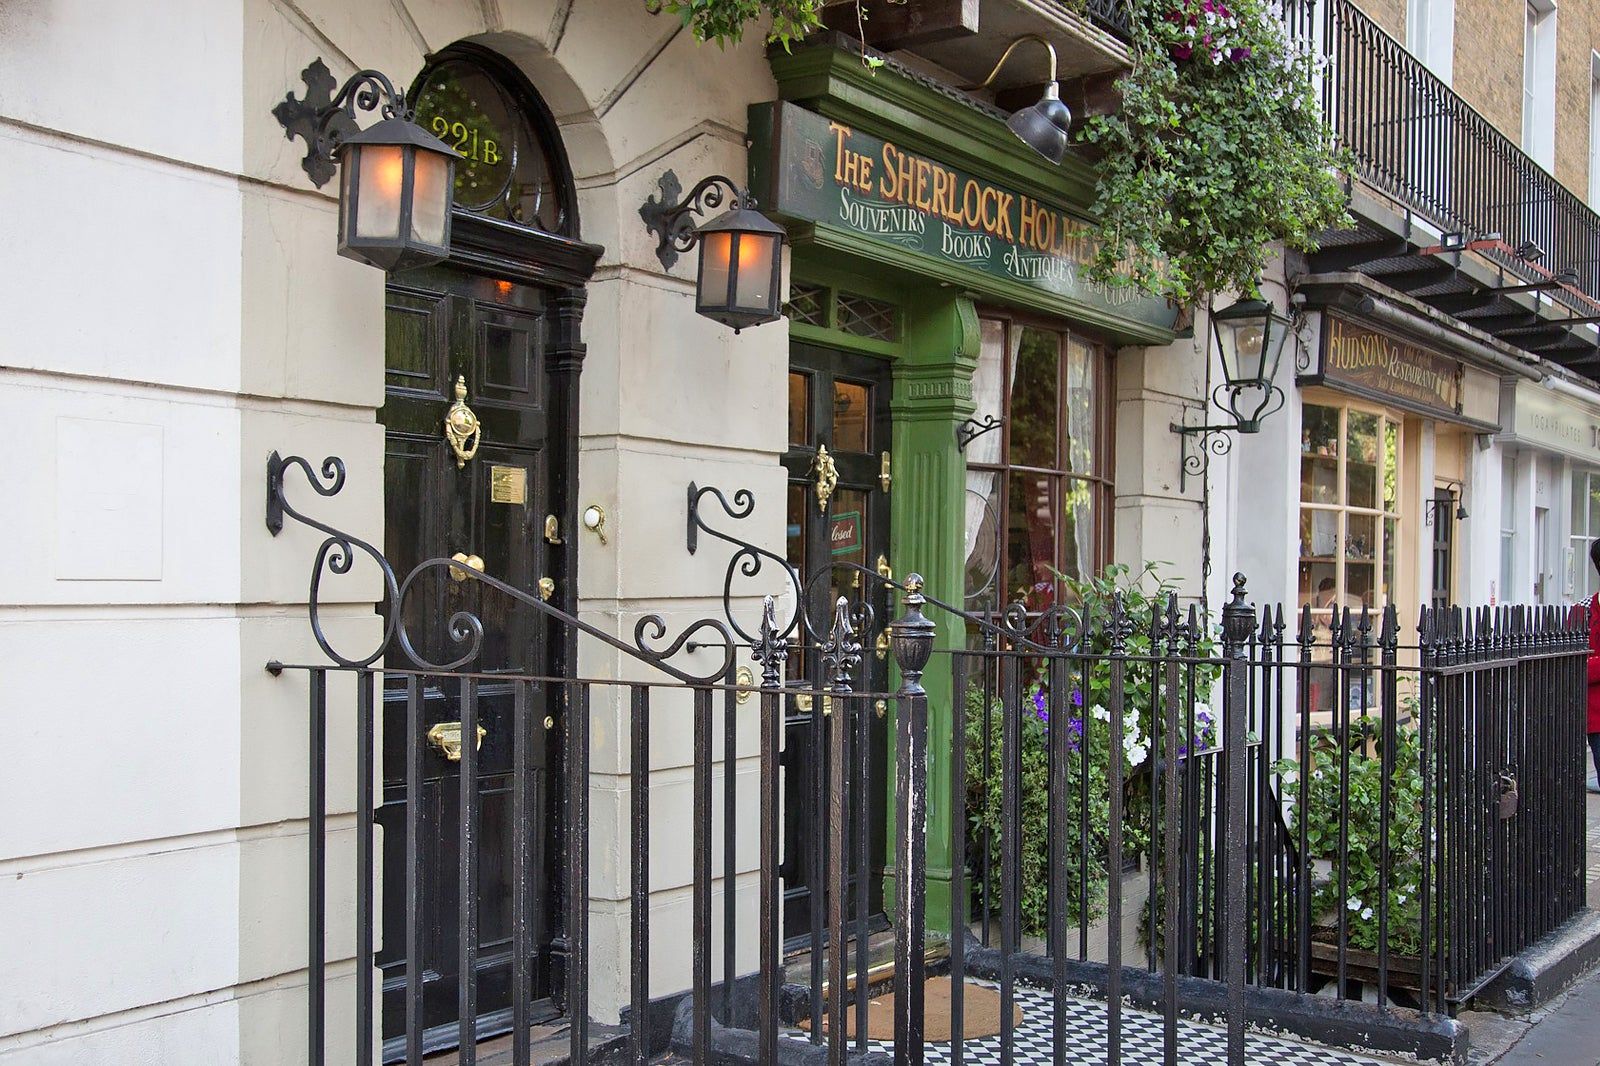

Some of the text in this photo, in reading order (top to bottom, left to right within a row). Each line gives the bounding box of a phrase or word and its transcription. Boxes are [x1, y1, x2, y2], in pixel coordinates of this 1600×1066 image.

[432, 116, 498, 165] 221B
[829, 121, 874, 192] THE
[880, 142, 1014, 240] SHERLOCK
[839, 186, 925, 235] SOUVENIRS
[941, 221, 991, 259] BOOKS
[1003, 245, 1074, 287] ANTIQUES
[1329, 320, 1389, 369] HUDSONS
[1387, 346, 1437, 390] RESTAURANT
[832, 524, 853, 541] losed
